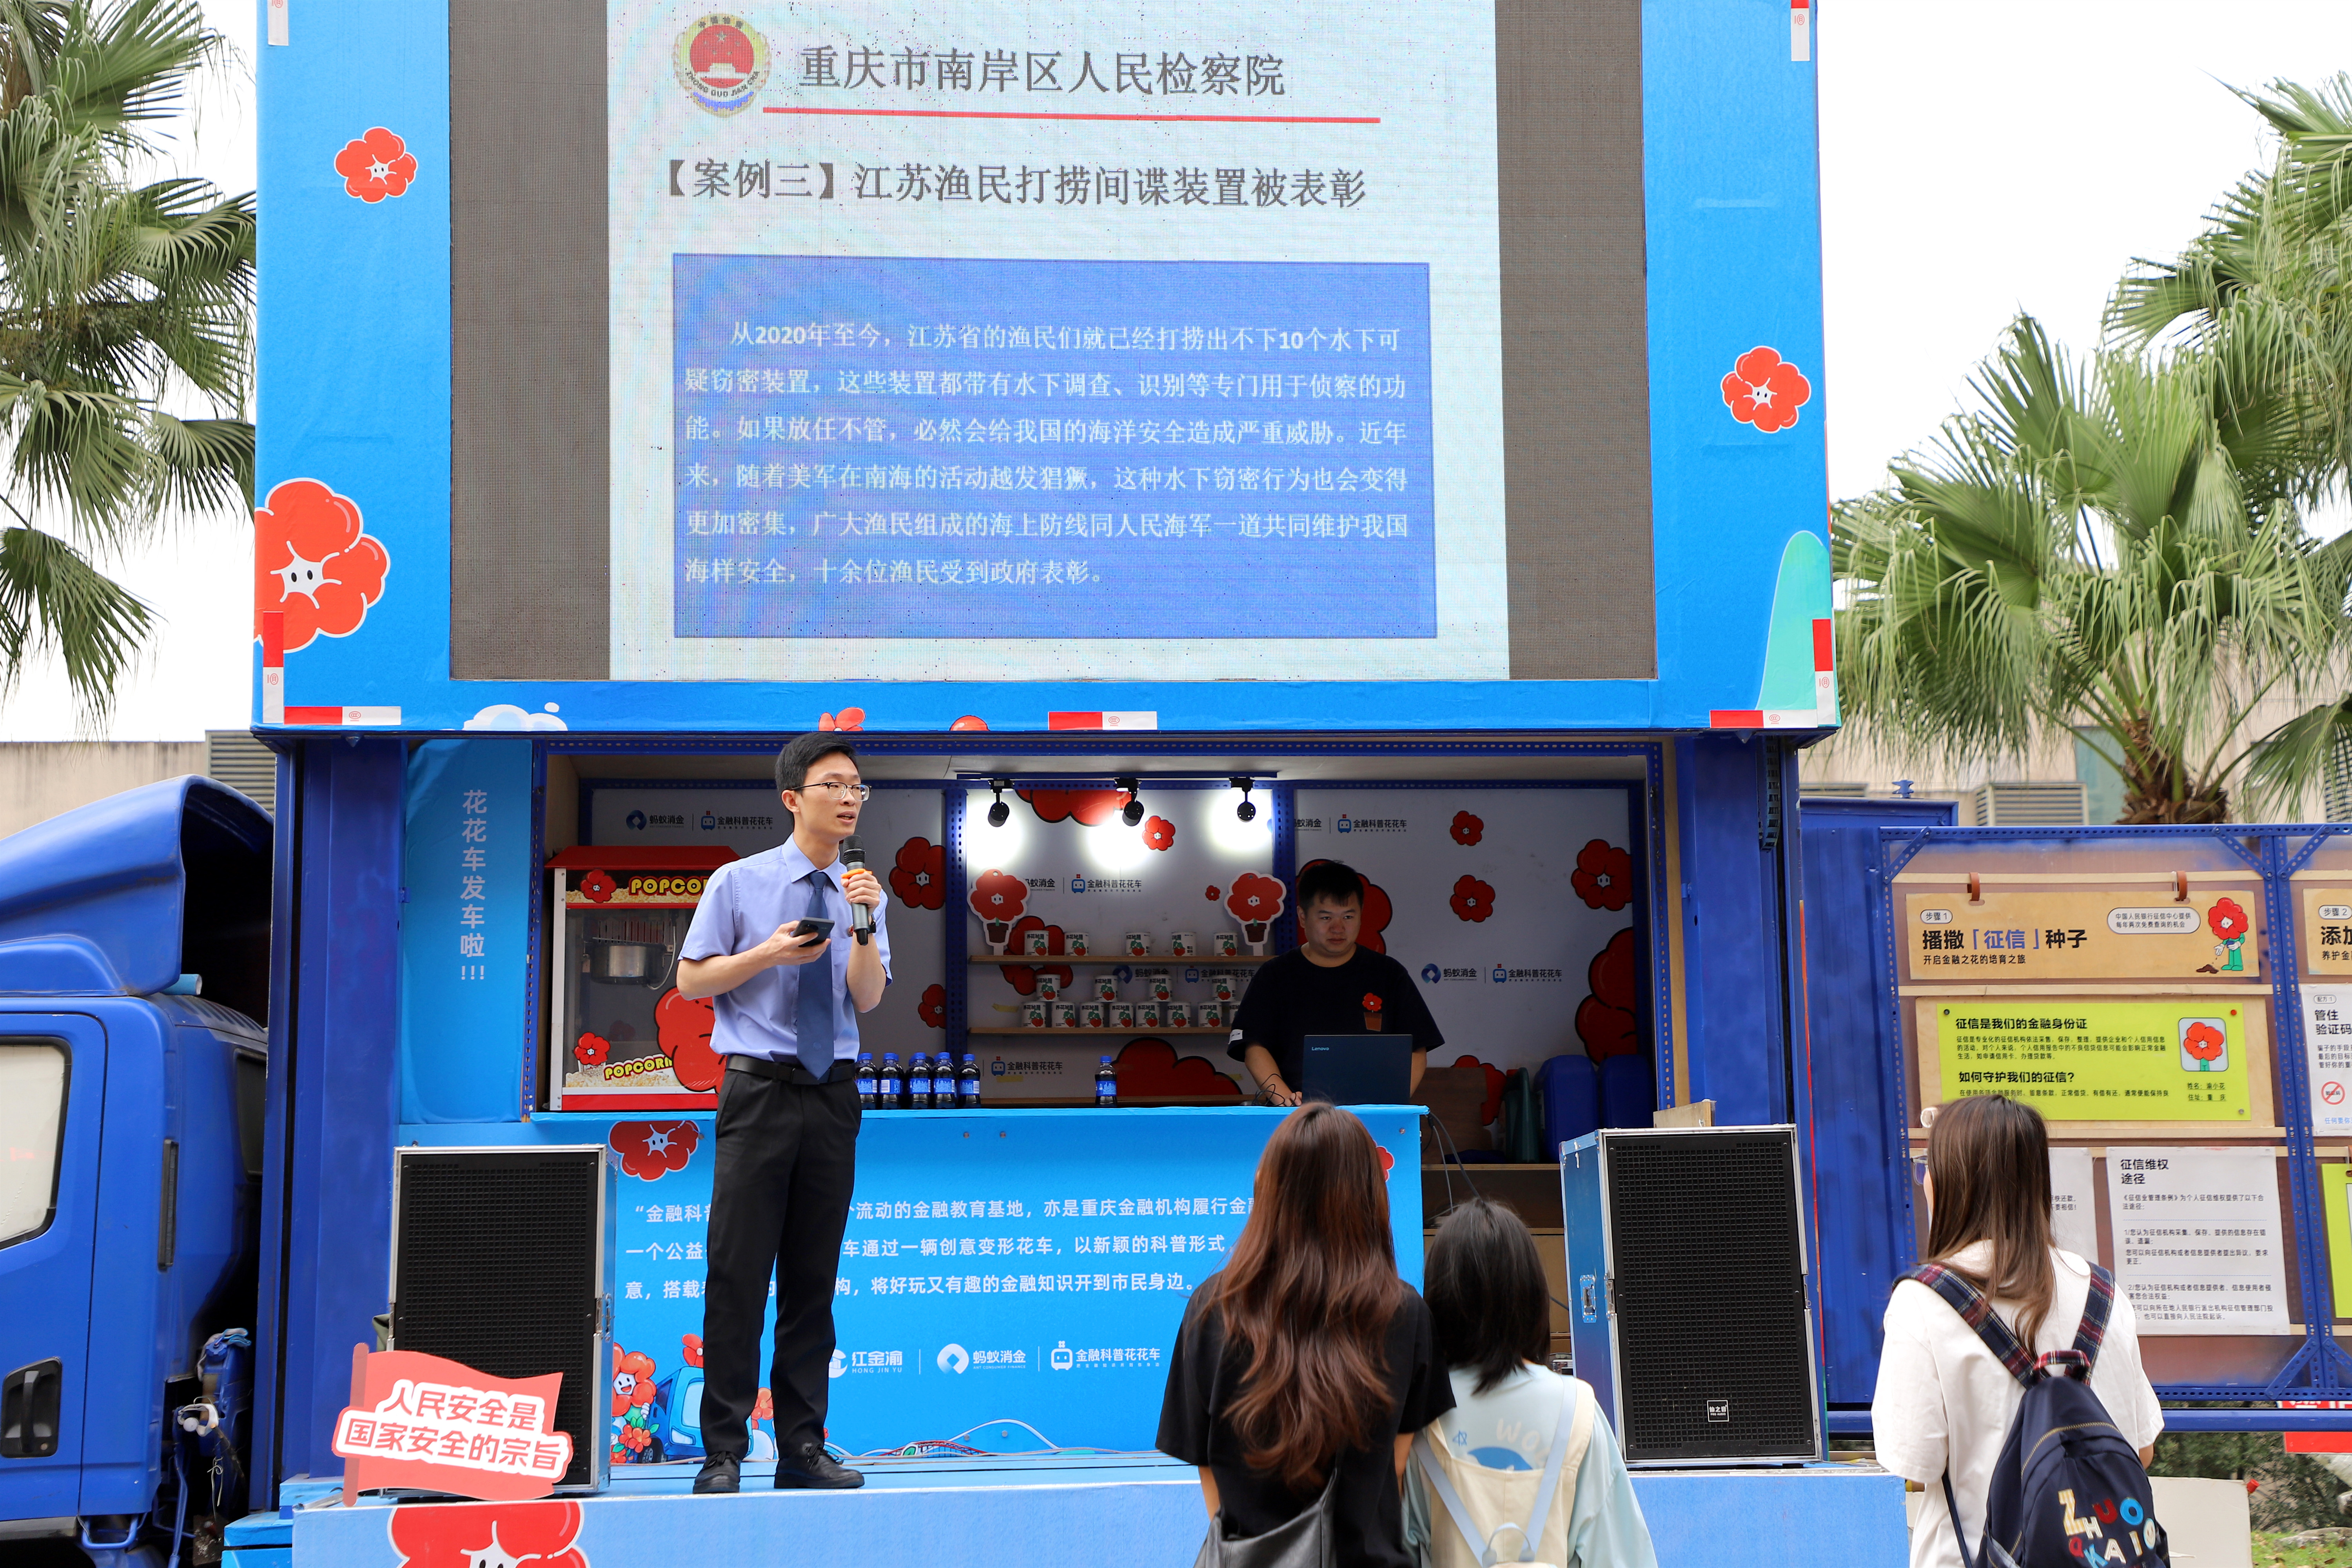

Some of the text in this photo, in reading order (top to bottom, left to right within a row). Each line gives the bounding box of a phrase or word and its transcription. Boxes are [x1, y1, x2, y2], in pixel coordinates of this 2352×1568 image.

[799, 46, 1286, 97] 重庆市南岸区人民检察院
[670, 159, 1365, 209] 【案例三】江苏渔民打捞间谍装置被表彰
[731, 321, 1401, 352] 从2020年至今，江苏省的渔民们就已经打捞出不下10个水下可
[684, 367, 1406, 400] 疑窃密装置，这些装置都带有水下调查、识别等专门用于侦察的功
[685, 415, 1407, 446] 能。如果放任不管，必然会给我国的海洋安全造成严重威胁。近年
[685, 462, 1408, 493] 来，随着美军在南海的活动越发猖獗，这种水下窃密行为也会变得
[686, 510, 1408, 540] 更加密集，广大渔民组成的海上防线同人民海军一道共同维护我国
[684, 557, 1103, 586] 海样安全，十余位渔民受到政府表彰。
[650, 815, 773, 826] 蚂蚁消金 金融科普花花车
[1354, 819, 1407, 828] 金融科普花花车
[460, 789, 487, 980] 花花车发车啦!!!
[1087, 880, 1142, 888] 金融科普花花车
[1926, 912, 1941, 921] 步骤
[2324, 907, 2340, 916] 步骤
[1922, 928, 2088, 950] 播撒「征信」种子
[1924, 954, 2026, 965] 开启金融之花的培育之旅
[2322, 950, 2352, 960] 养护金
[1443, 968, 1563, 978] 蚂蚁消金 金融科普花花车
[1956, 1018, 2088, 1030] 征信是我们的金融身份证
[2314, 1009, 2339, 1021] 管住
[2316, 1024, 2352, 1035] 验证码
[1007, 1061, 1063, 1071] 金融科普花花车
[1959, 1071, 2074, 1083] 如何守护我们的征信？
[2120, 1158, 2170, 1171] 征信维权
[2121, 1173, 2146, 1185] 途径
[849, 1197, 1254, 1219] 流动的金融教育基地，亦是重庆金融机构履行金
[626, 1241, 707, 1261] 一个公益
[625, 1272, 1193, 1300] 意，搭载 构，将好玩又有趣的金融知识开到市民身边。
[852, 1348, 1160, 1367] 红金渝 蚂蚁消金 金融科普花花车
[383, 1386, 539, 1432] 人民安全是
[345, 1417, 561, 1471] 国家安全的宗旨
